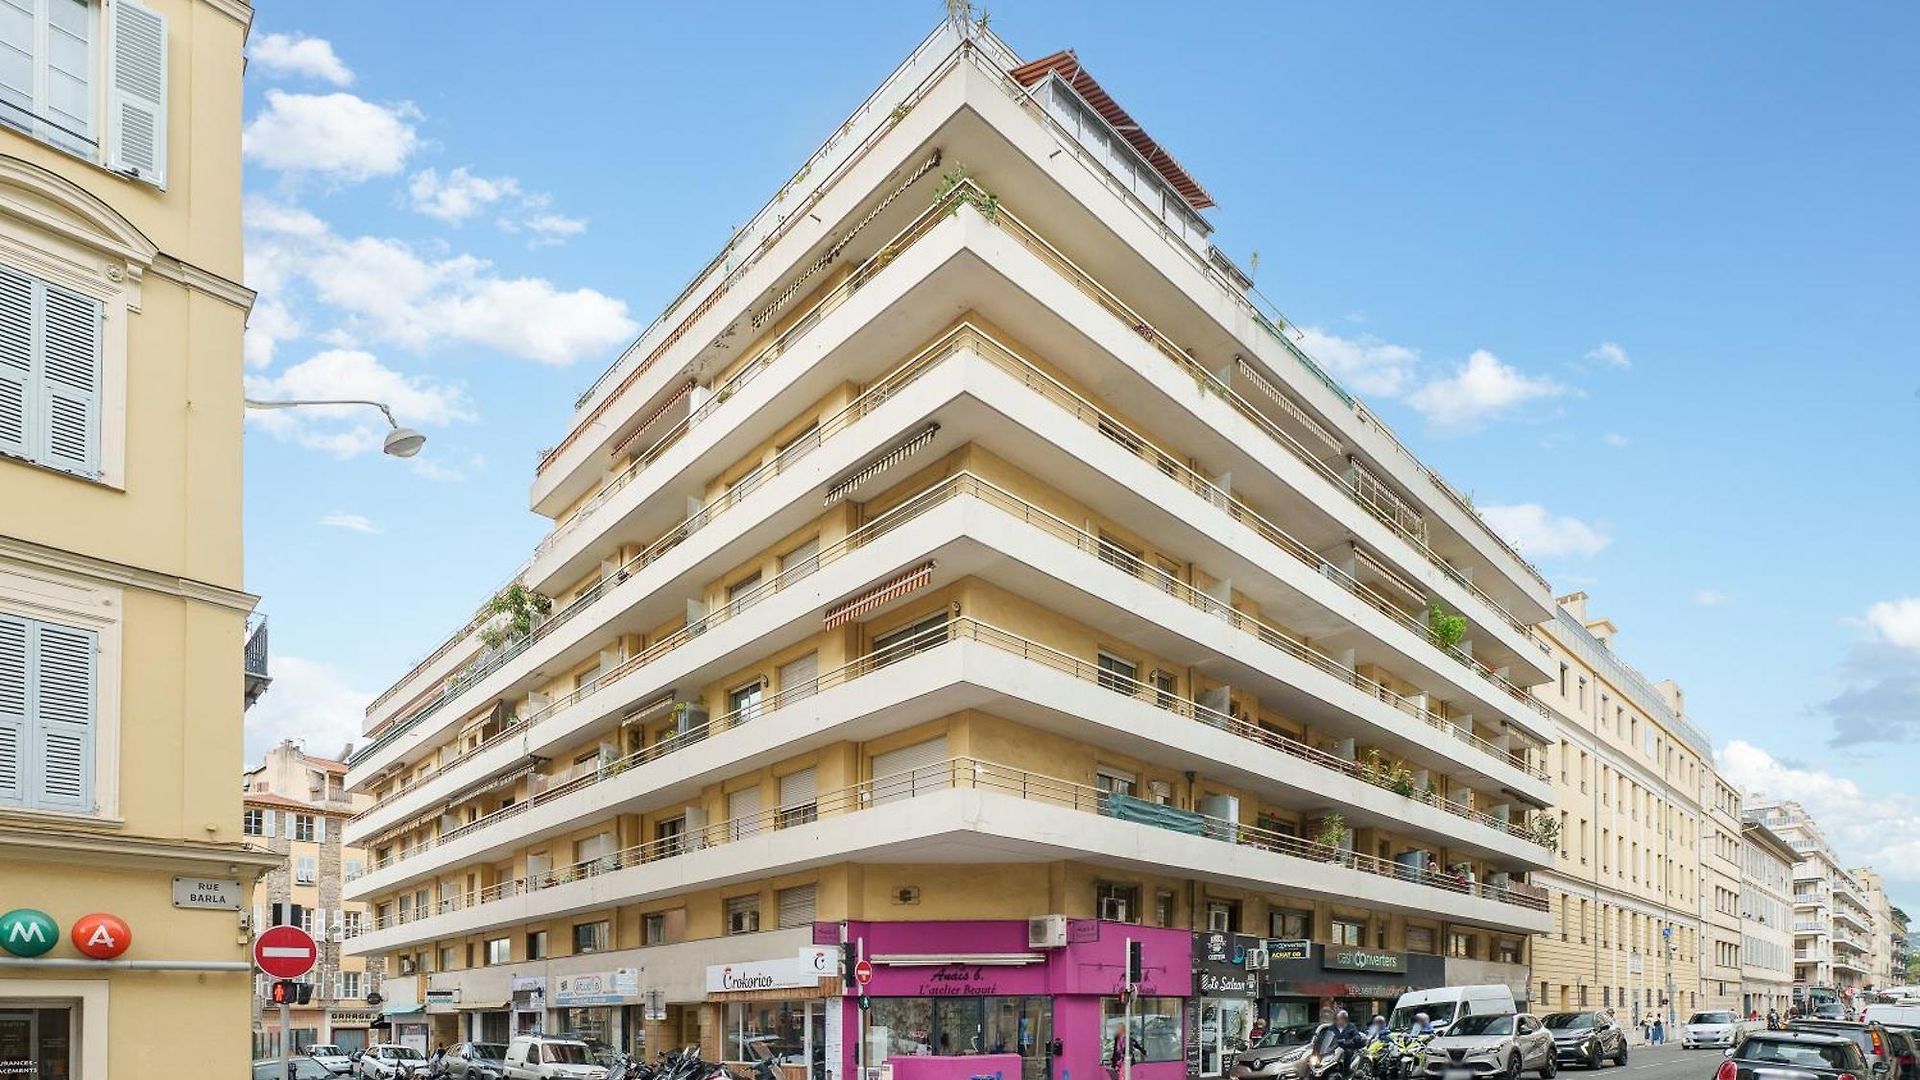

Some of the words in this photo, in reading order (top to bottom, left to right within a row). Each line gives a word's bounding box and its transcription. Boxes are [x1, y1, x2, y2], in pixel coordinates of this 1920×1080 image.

[198, 882, 220, 892] RUE
[190, 893, 226, 904] BARLA
[9, 921, 46, 944] M
[87, 924, 115, 948] A
[1271, 952, 1292, 960] ACHAT
[1354, 950, 1398, 968] converters
[722, 971, 774, 990] Crokorico
[1208, 977, 1219, 990] Le
[1220, 976, 1246, 992] Salon
[919, 984, 960, 995] L'atelier
[964, 983, 997, 994] Beauté
